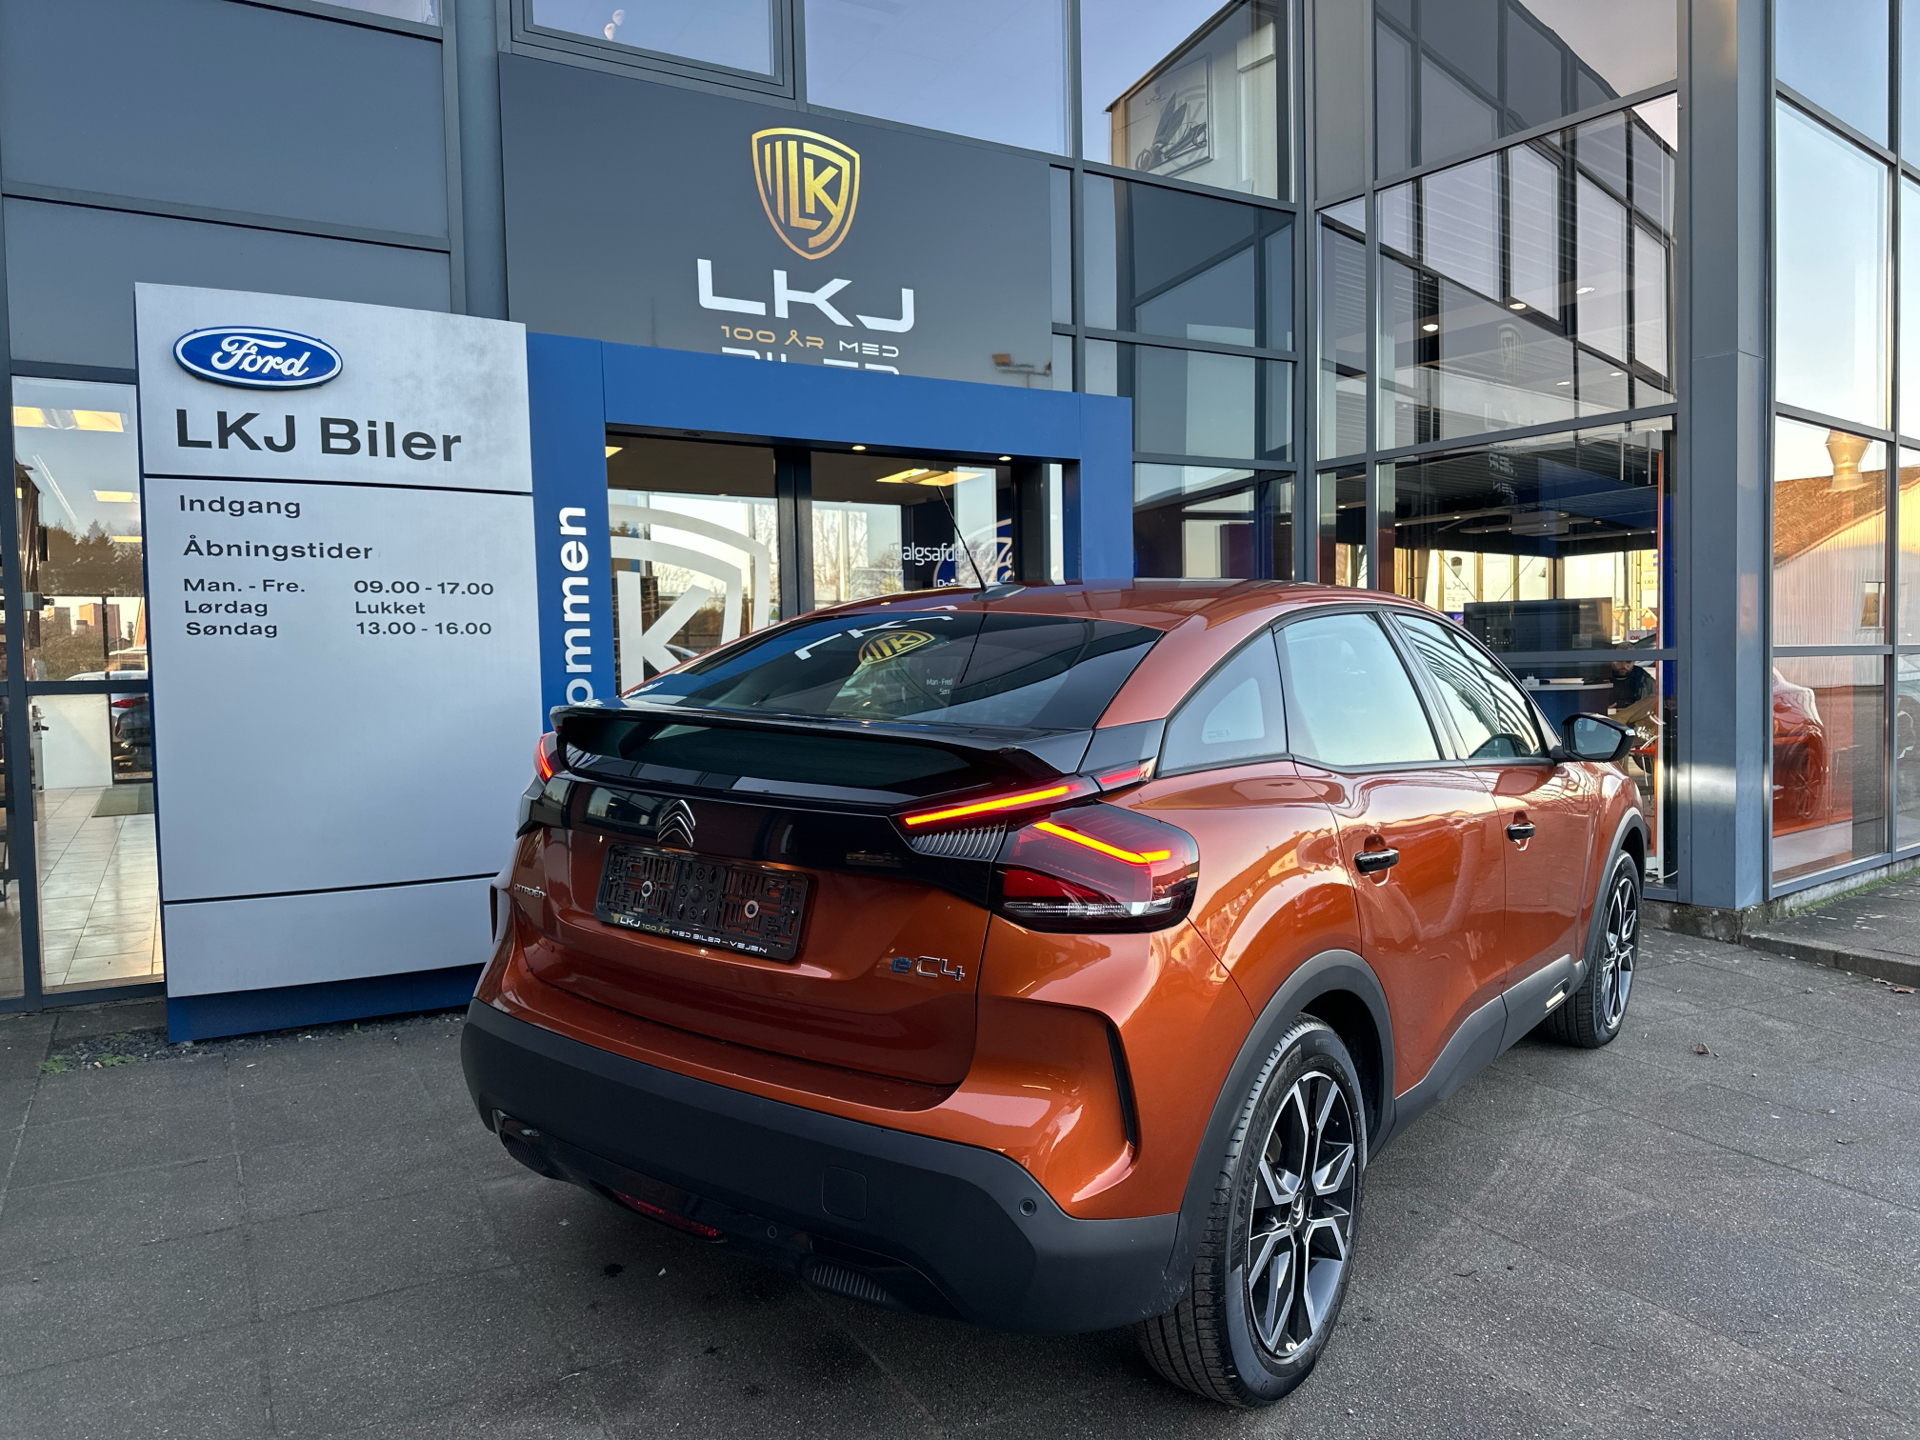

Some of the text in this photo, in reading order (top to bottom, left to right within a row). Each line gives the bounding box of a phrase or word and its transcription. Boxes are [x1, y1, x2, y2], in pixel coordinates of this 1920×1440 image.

[697, 258, 915, 333] LKJ
[211, 335, 311, 377] Ford
[720, 325, 900, 358] 100 ÅR MED
[176, 408, 462, 462] LKJ Biler
[179, 494, 301, 519] Indgang
[183, 534, 373, 562] Åbningstider
[183, 578, 242, 593] Man.
[262, 579, 306, 593] Fre.
[353, 580, 420, 594] 09.00
[437, 581, 494, 596] 17.00
[184, 599, 426, 617] Lørdag Lukket
[186, 621, 278, 639] Søndag
[356, 621, 416, 635] 13.00
[434, 621, 492, 635] 16.00
[619, 916, 641, 928] LKJ
[642, 923, 657, 931] 100
[671, 929, 692, 938] MED
[692, 933, 721, 944] BILER
[729, 940, 768, 954] VEJEN
